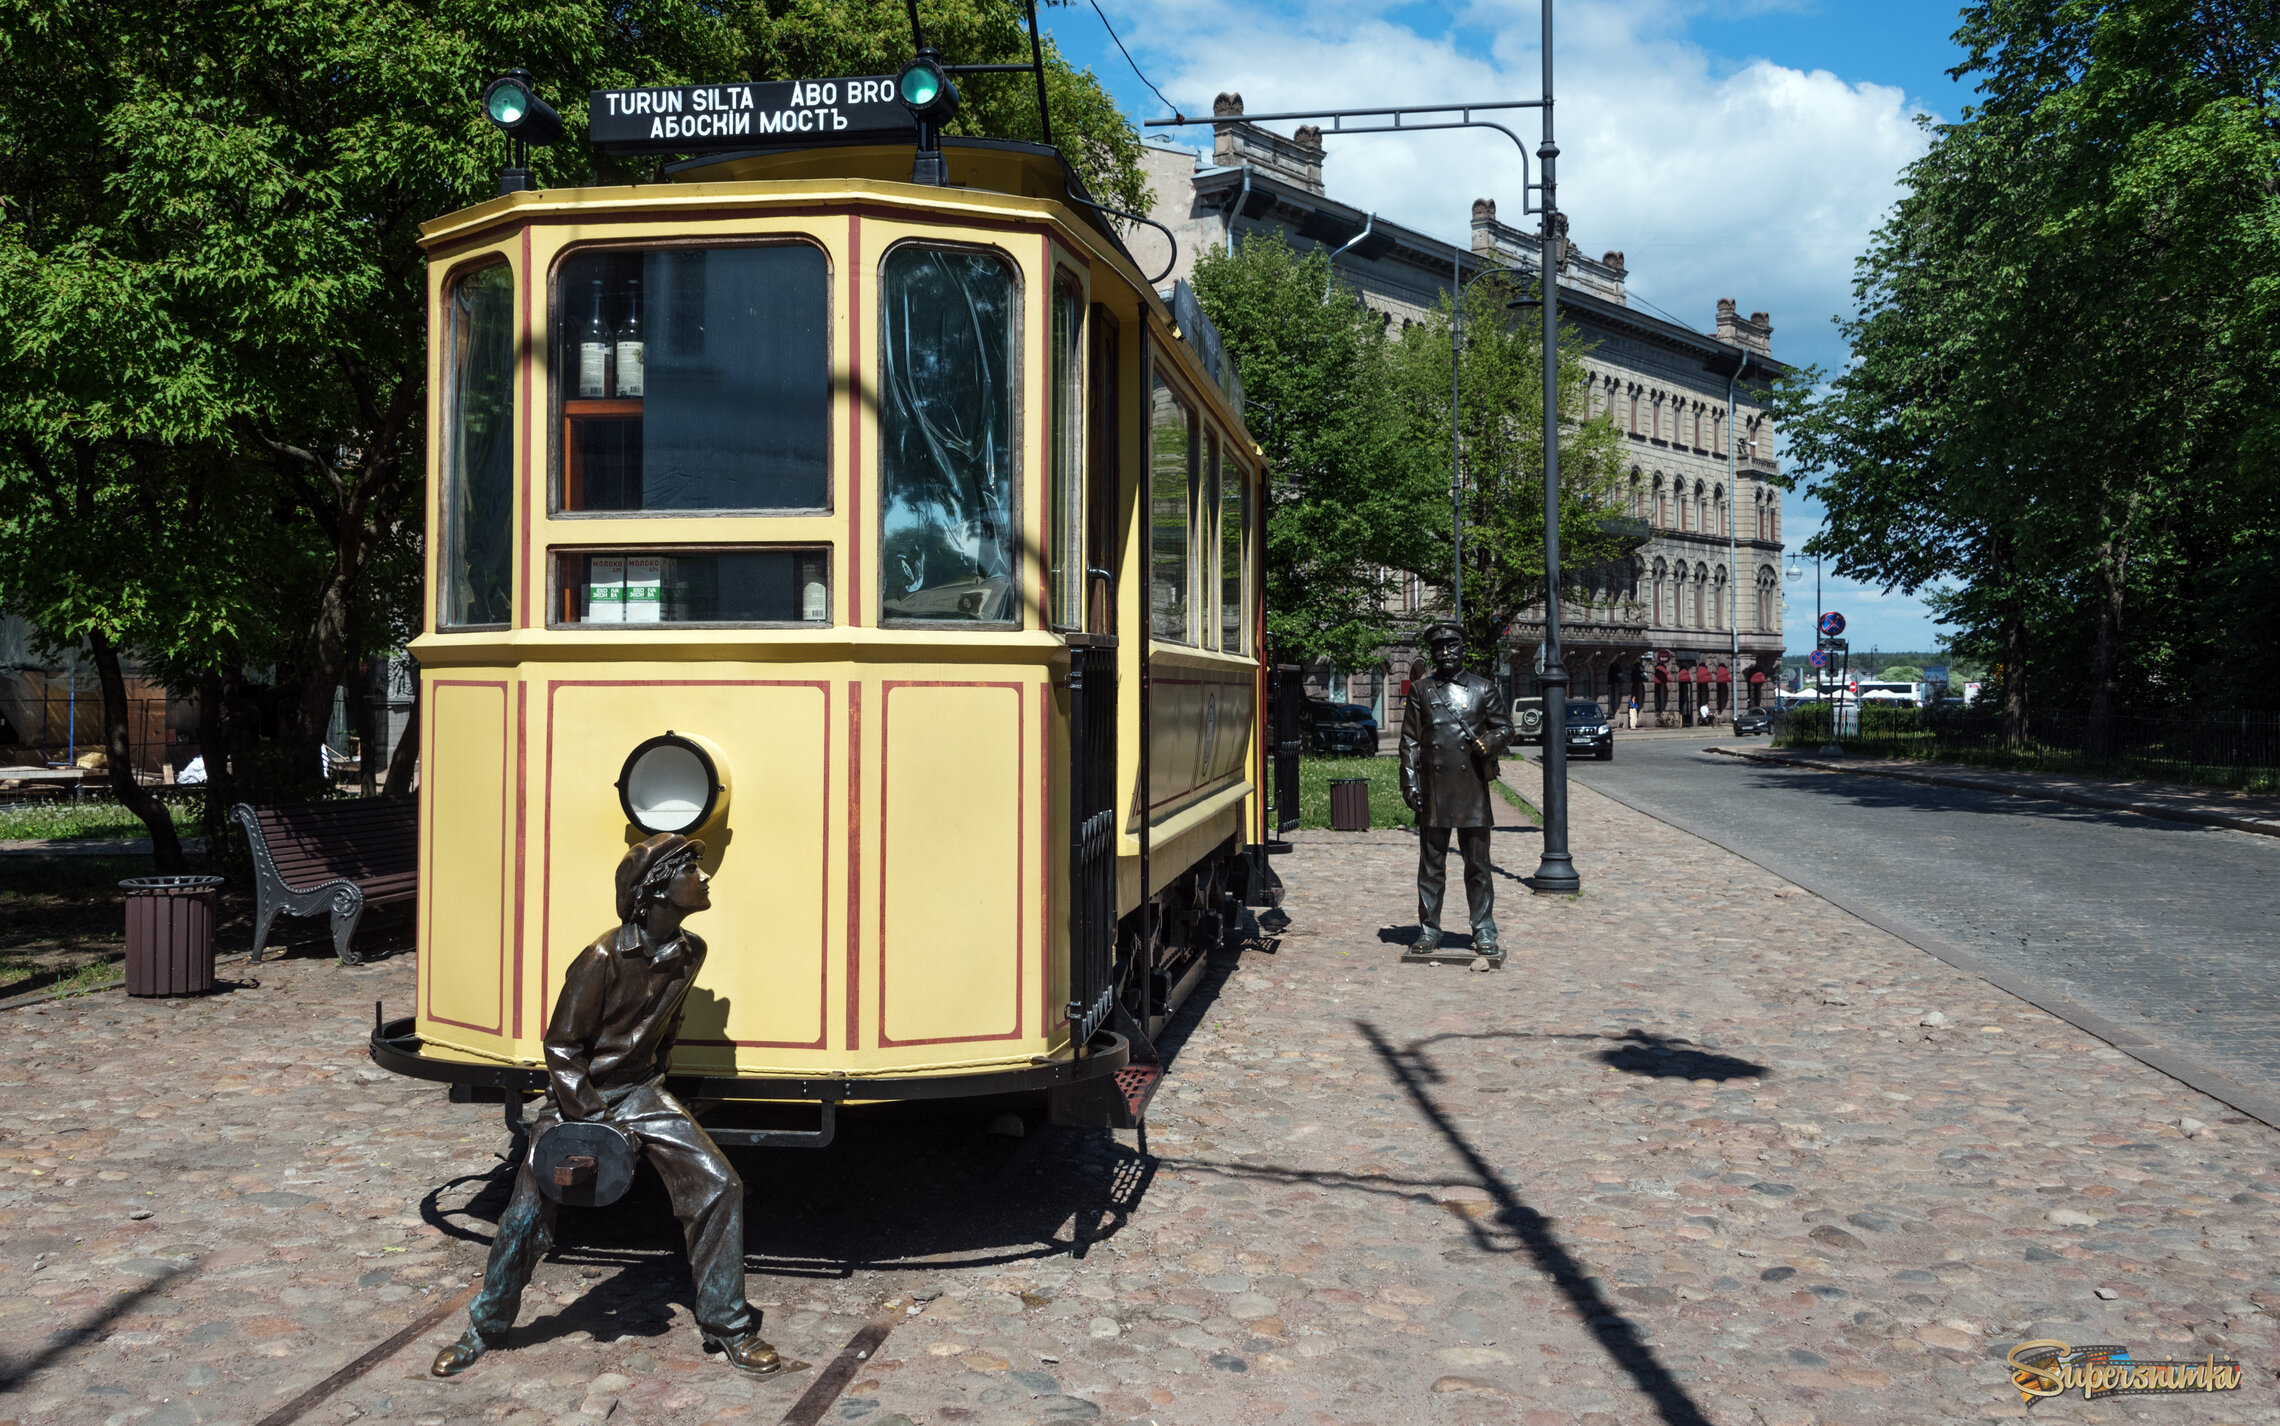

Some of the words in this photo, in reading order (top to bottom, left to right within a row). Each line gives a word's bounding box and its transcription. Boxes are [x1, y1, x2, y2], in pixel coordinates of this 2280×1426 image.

[606, 90, 682, 115] TURUN
[692, 87, 754, 111] SILTA
[847, 80, 895, 104] BRO
[760, 108, 848, 134] МОСТЪ
